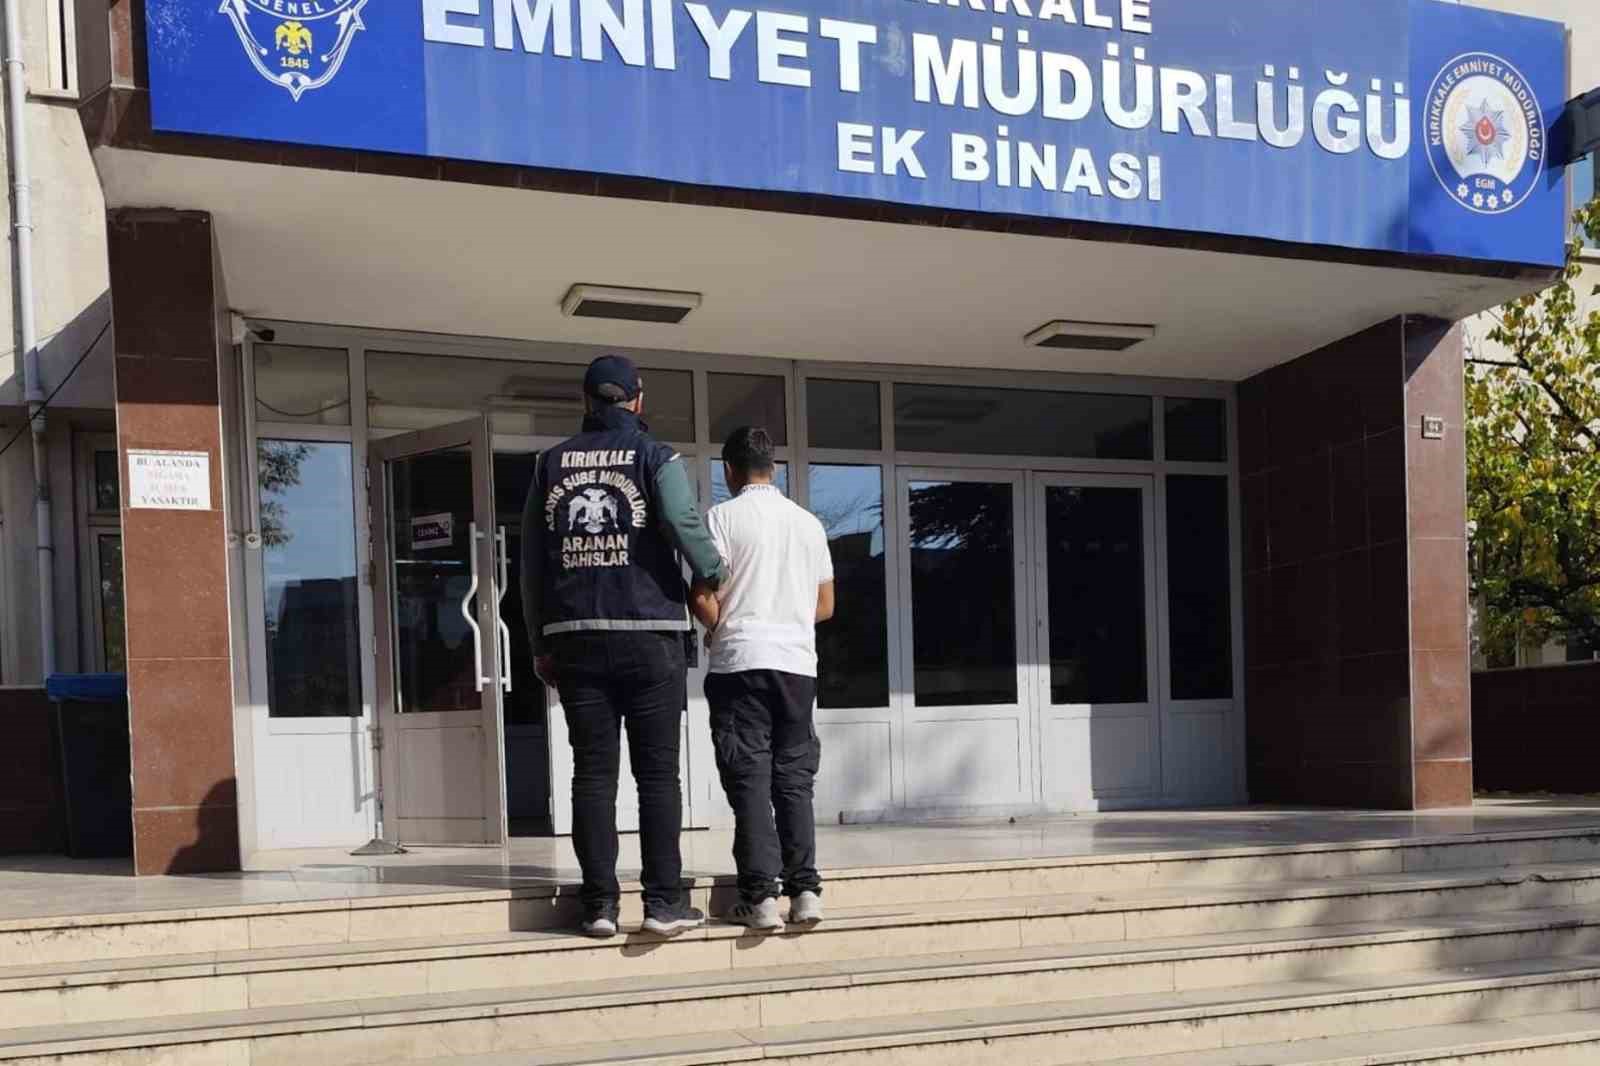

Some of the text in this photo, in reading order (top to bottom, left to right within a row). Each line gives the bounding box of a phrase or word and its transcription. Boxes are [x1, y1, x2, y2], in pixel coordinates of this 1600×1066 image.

[912, 27, 1411, 160] MÜDÜRLÜĞÜ
[1430, 73, 1456, 146] KIRIKKALE
[837, 121, 1162, 200] EK BİNASI
[1475, 177, 1496, 190] EGM
[561, 450, 636, 467] KIRIKKALE
[562, 534, 628, 552] ARANAN
